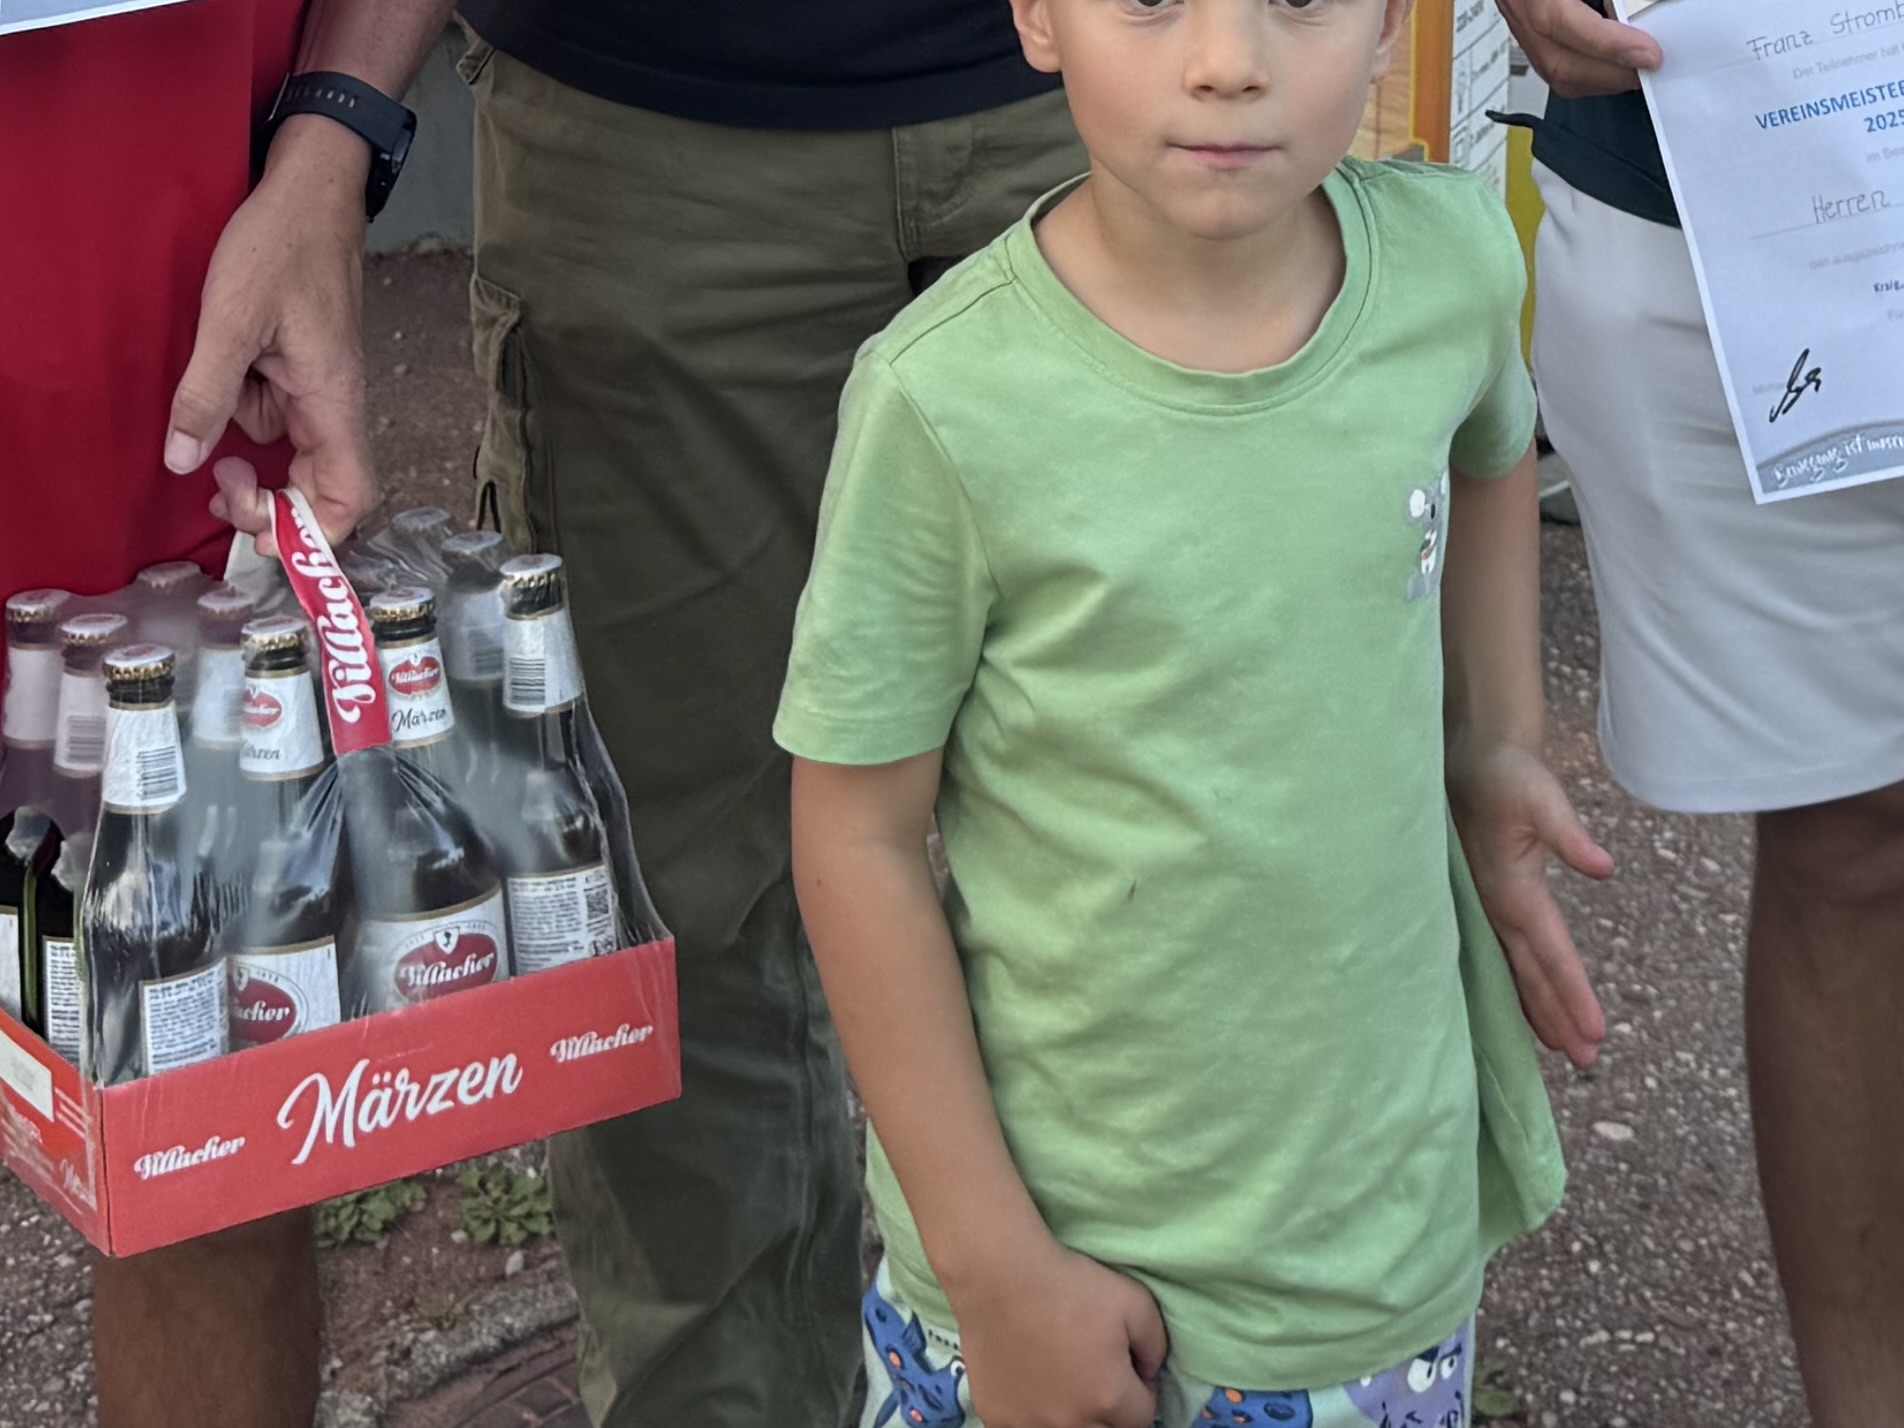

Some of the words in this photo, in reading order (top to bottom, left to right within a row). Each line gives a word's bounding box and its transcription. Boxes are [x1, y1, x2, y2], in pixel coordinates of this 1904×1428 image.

[1747, 31, 1815, 61] Franz
[1812, 189, 1891, 225] Herren
[392, 707, 446, 732] Märzen
[277, 1052, 524, 1166] Märzen
[549, 1023, 654, 1063] Villacher
[134, 1136, 246, 1181] Villacher
